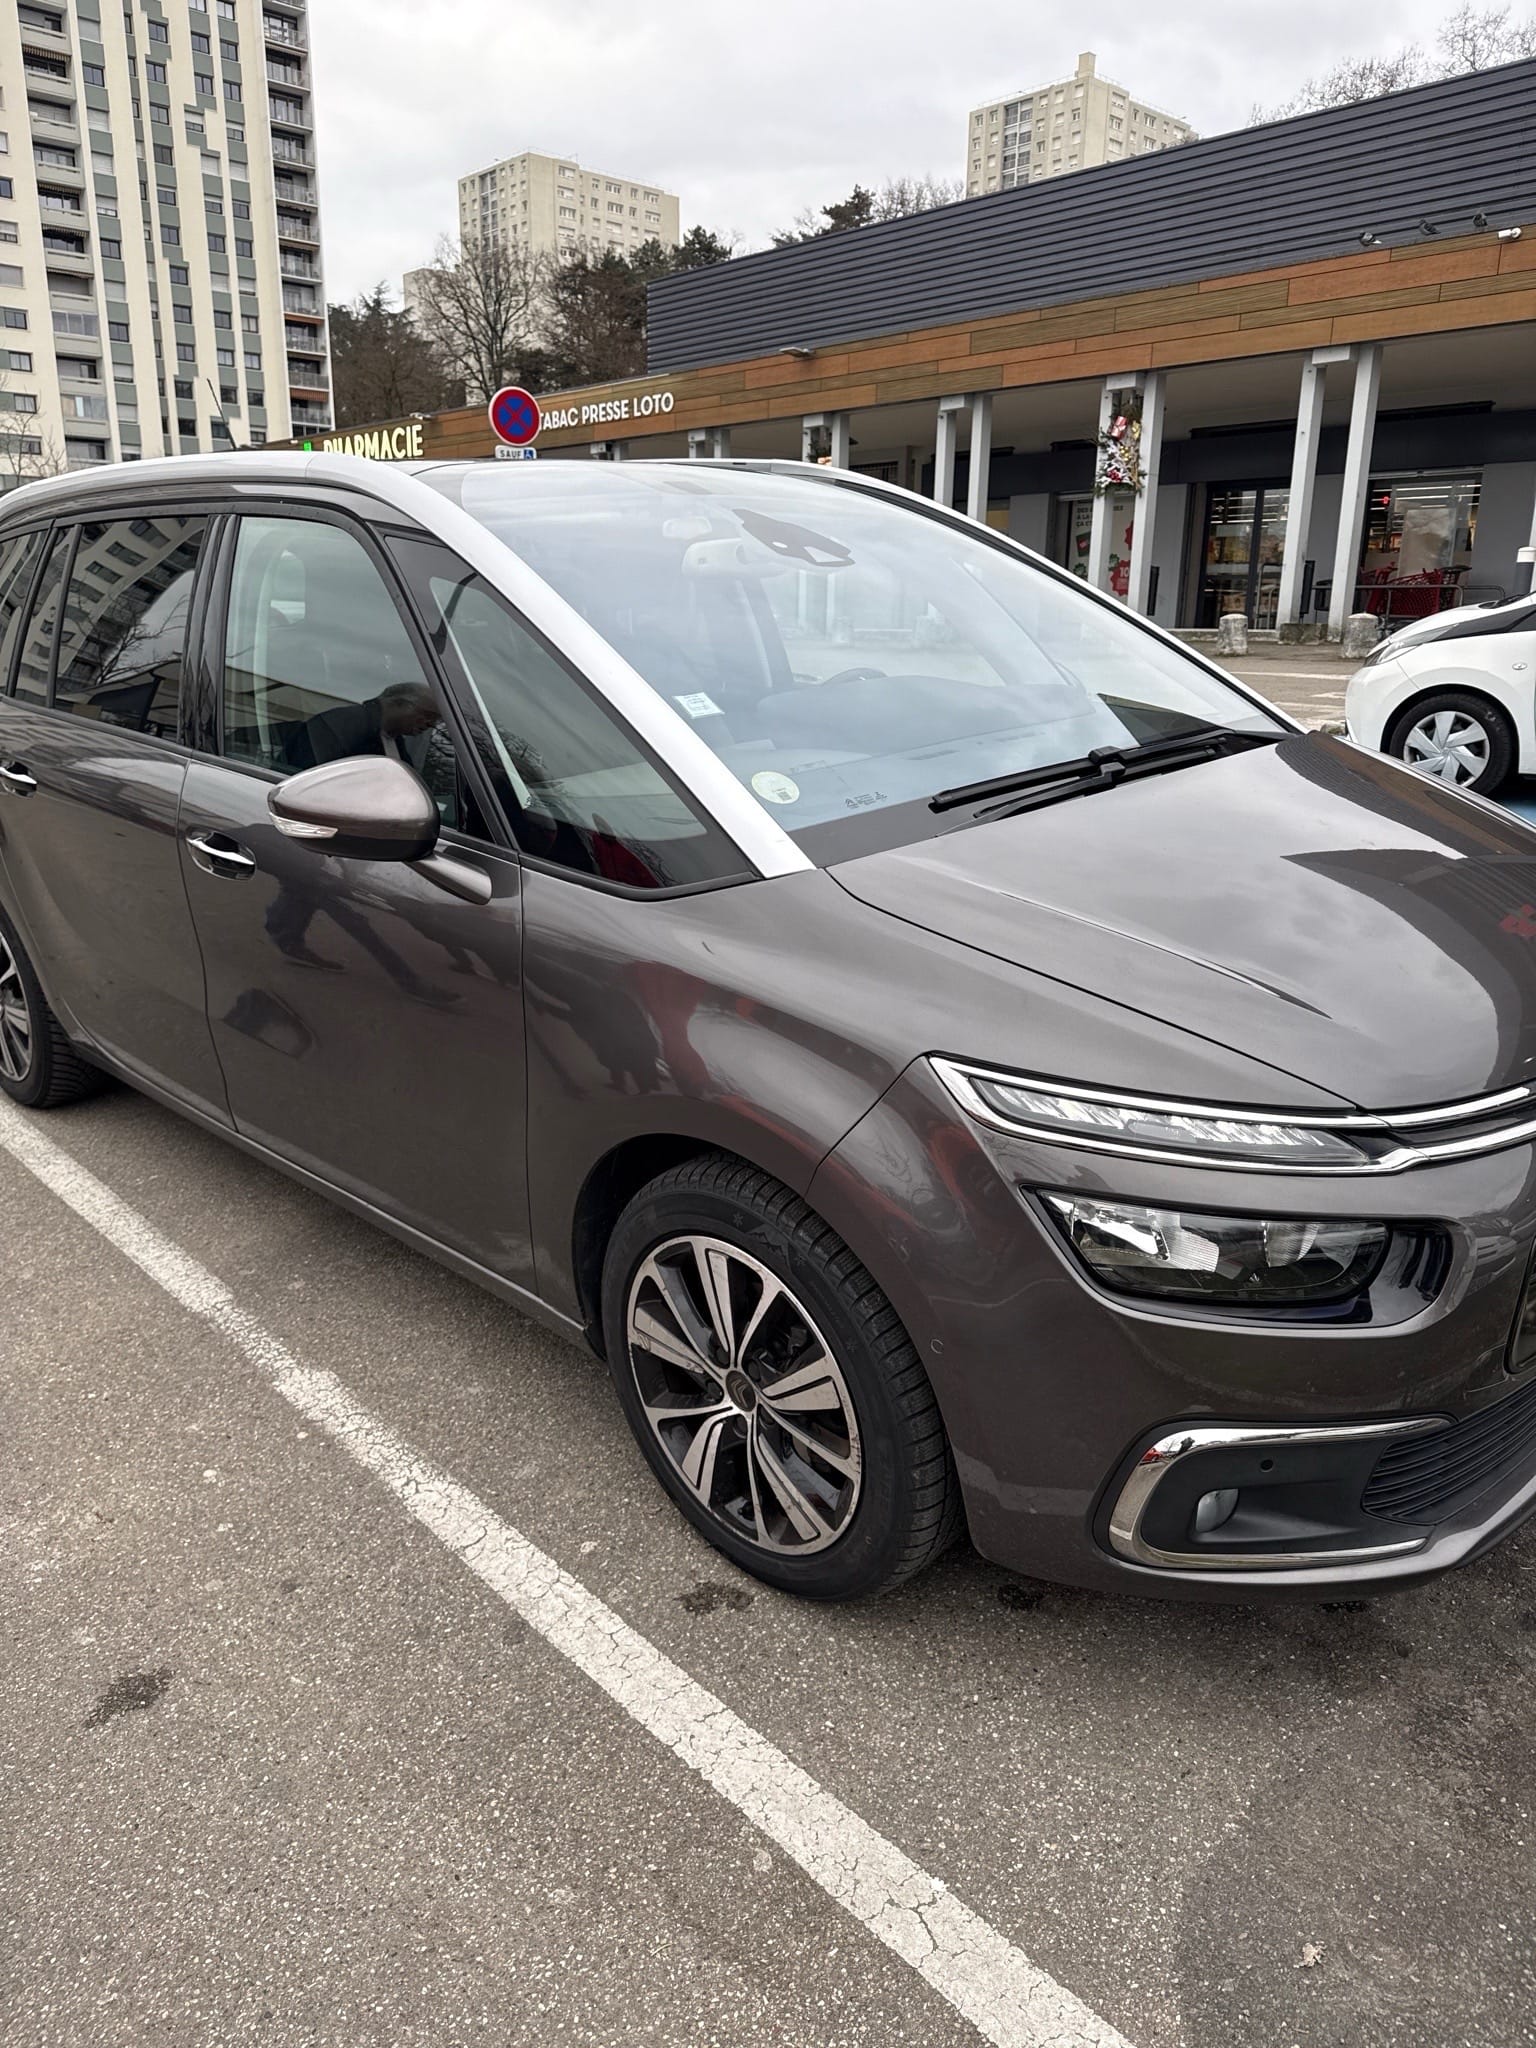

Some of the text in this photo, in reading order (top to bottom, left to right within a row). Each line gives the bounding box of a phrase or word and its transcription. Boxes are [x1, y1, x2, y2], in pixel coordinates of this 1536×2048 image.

[540, 392, 674, 431] TABAC PRESSE LOTO
[323, 424, 424, 459] PHARMACIE
[499, 450, 522, 458] SAUF
